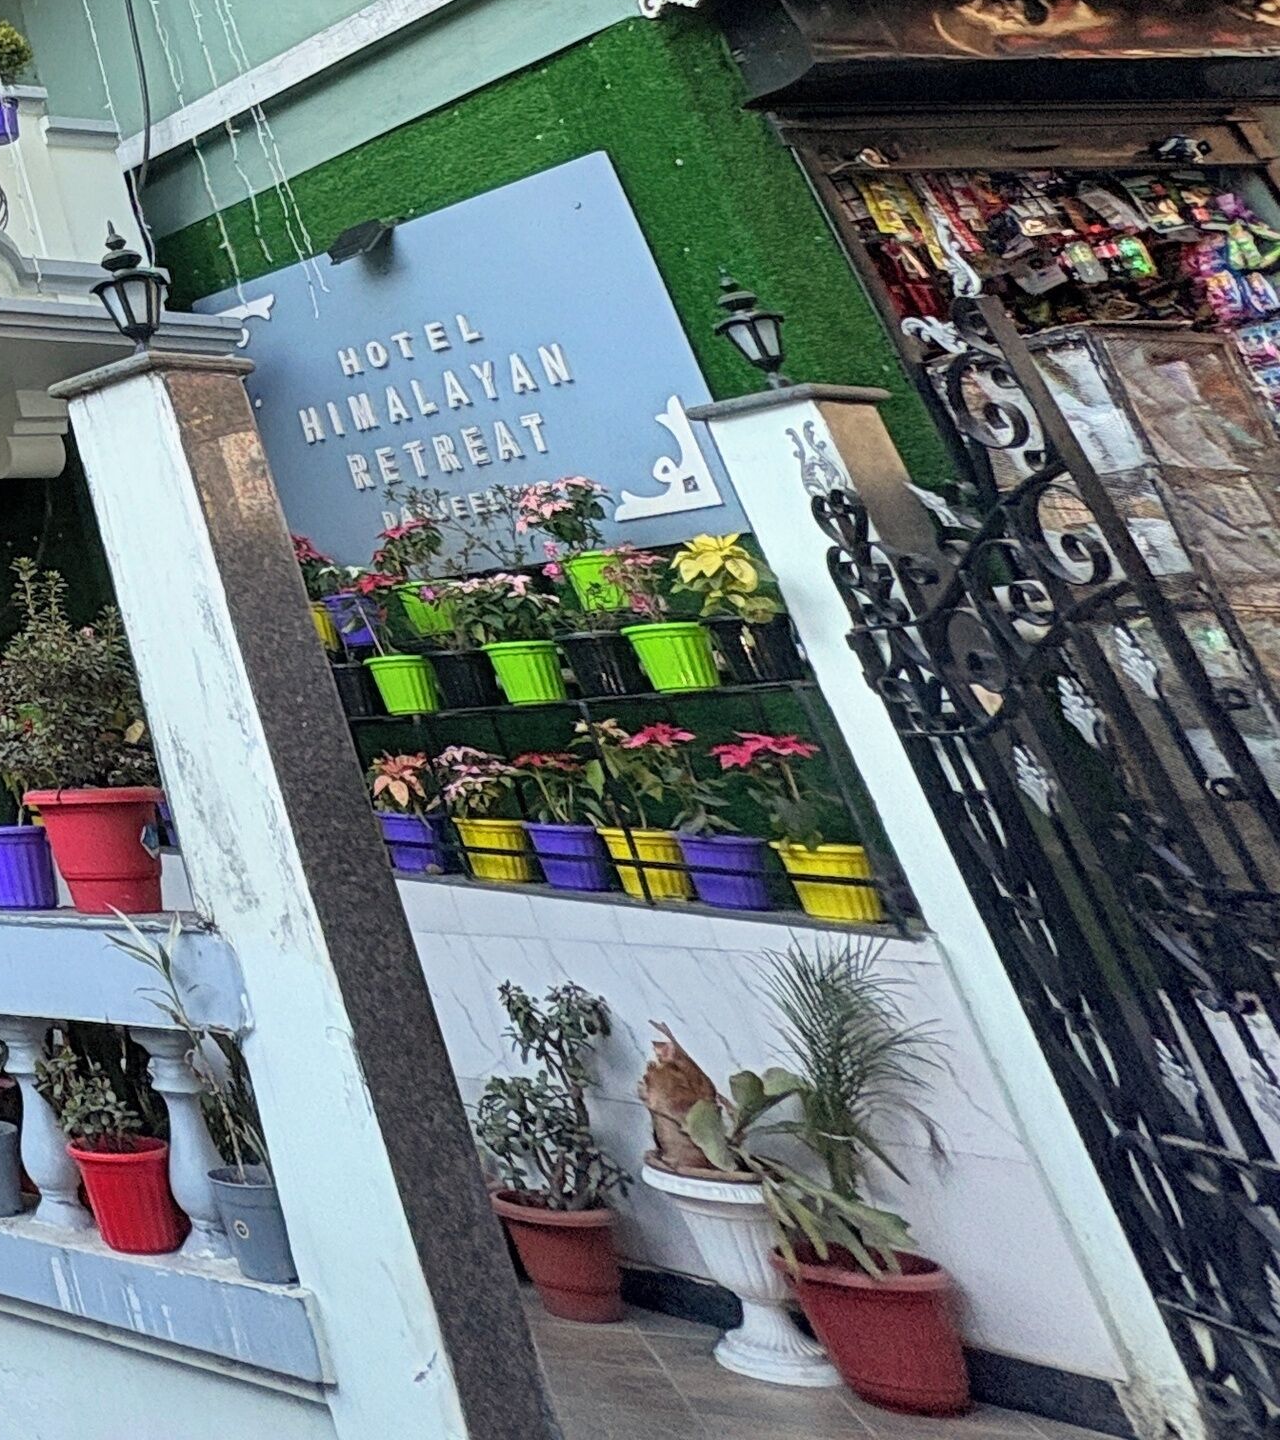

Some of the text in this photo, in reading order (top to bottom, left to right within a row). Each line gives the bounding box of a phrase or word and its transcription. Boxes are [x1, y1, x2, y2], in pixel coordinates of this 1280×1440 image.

[337, 314, 482, 377] HOTEL
[298, 343, 576, 444] HIMALAYAN
[346, 413, 548, 491] RETREAT
